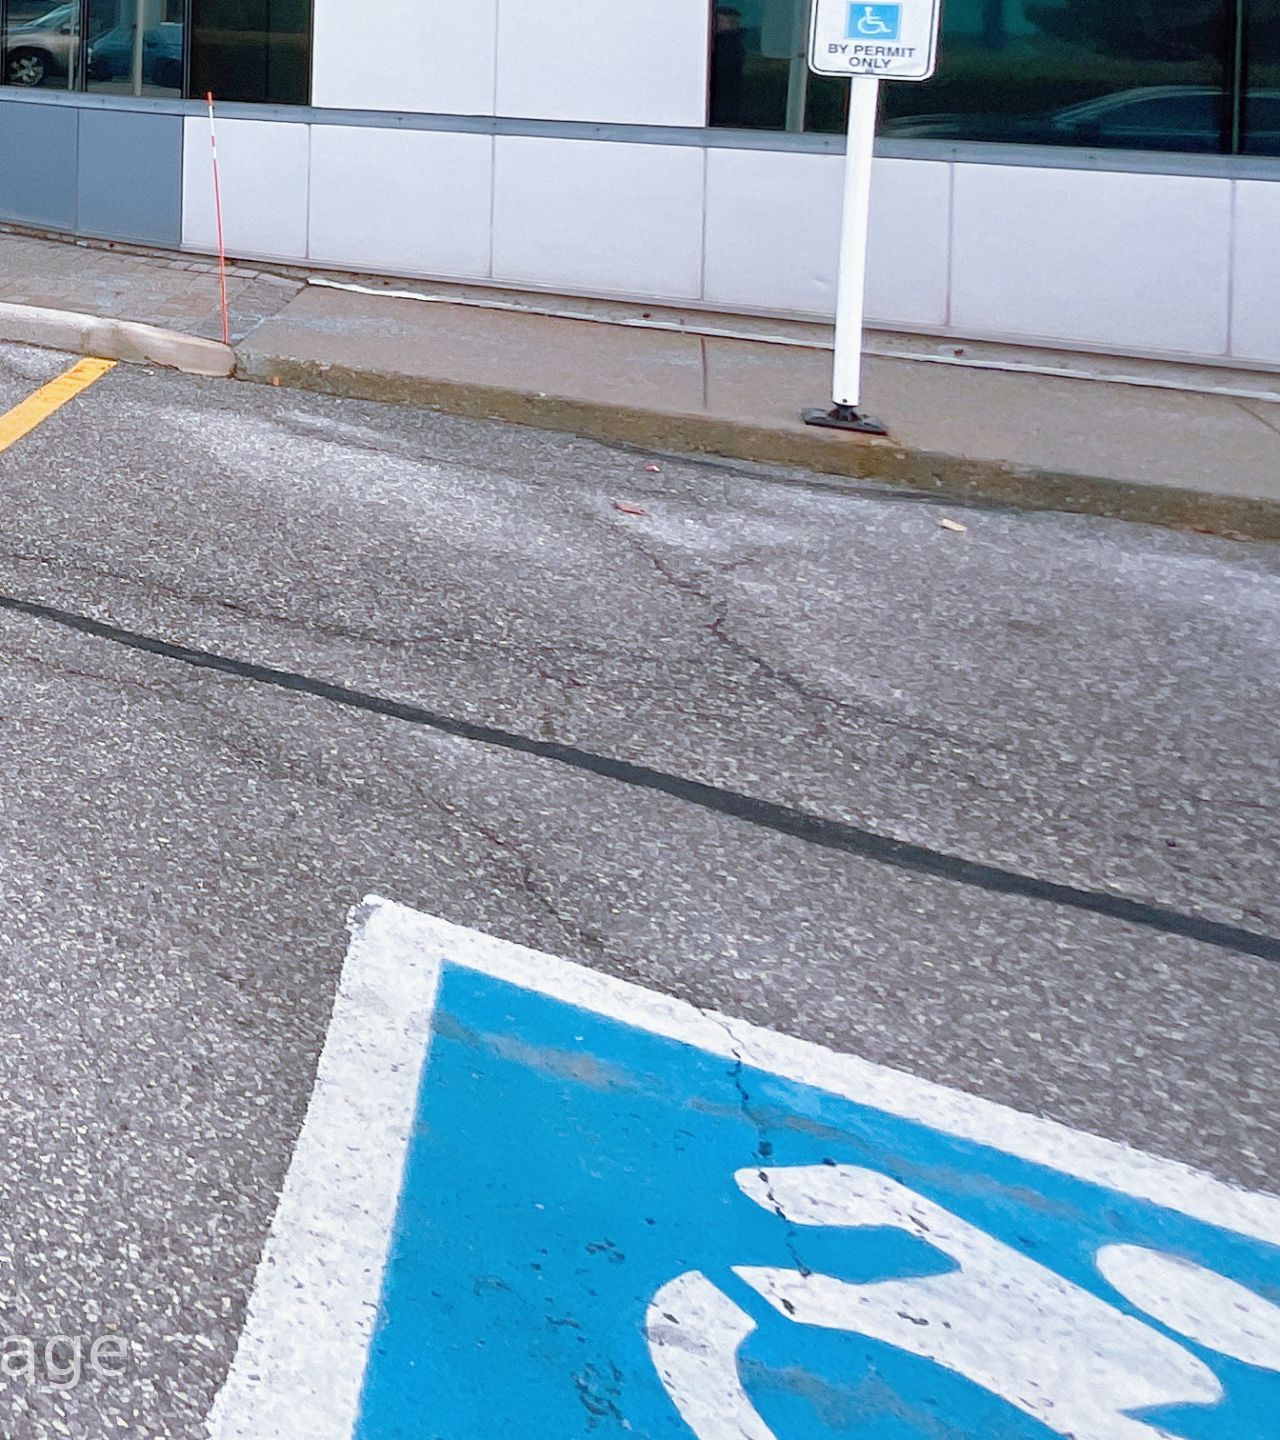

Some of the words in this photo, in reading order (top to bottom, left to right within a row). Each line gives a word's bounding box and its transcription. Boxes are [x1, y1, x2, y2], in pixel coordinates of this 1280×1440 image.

[828, 43, 849, 54] BY
[854, 44, 917, 58] PERMIT
[849, 56, 892, 69] ONLY
